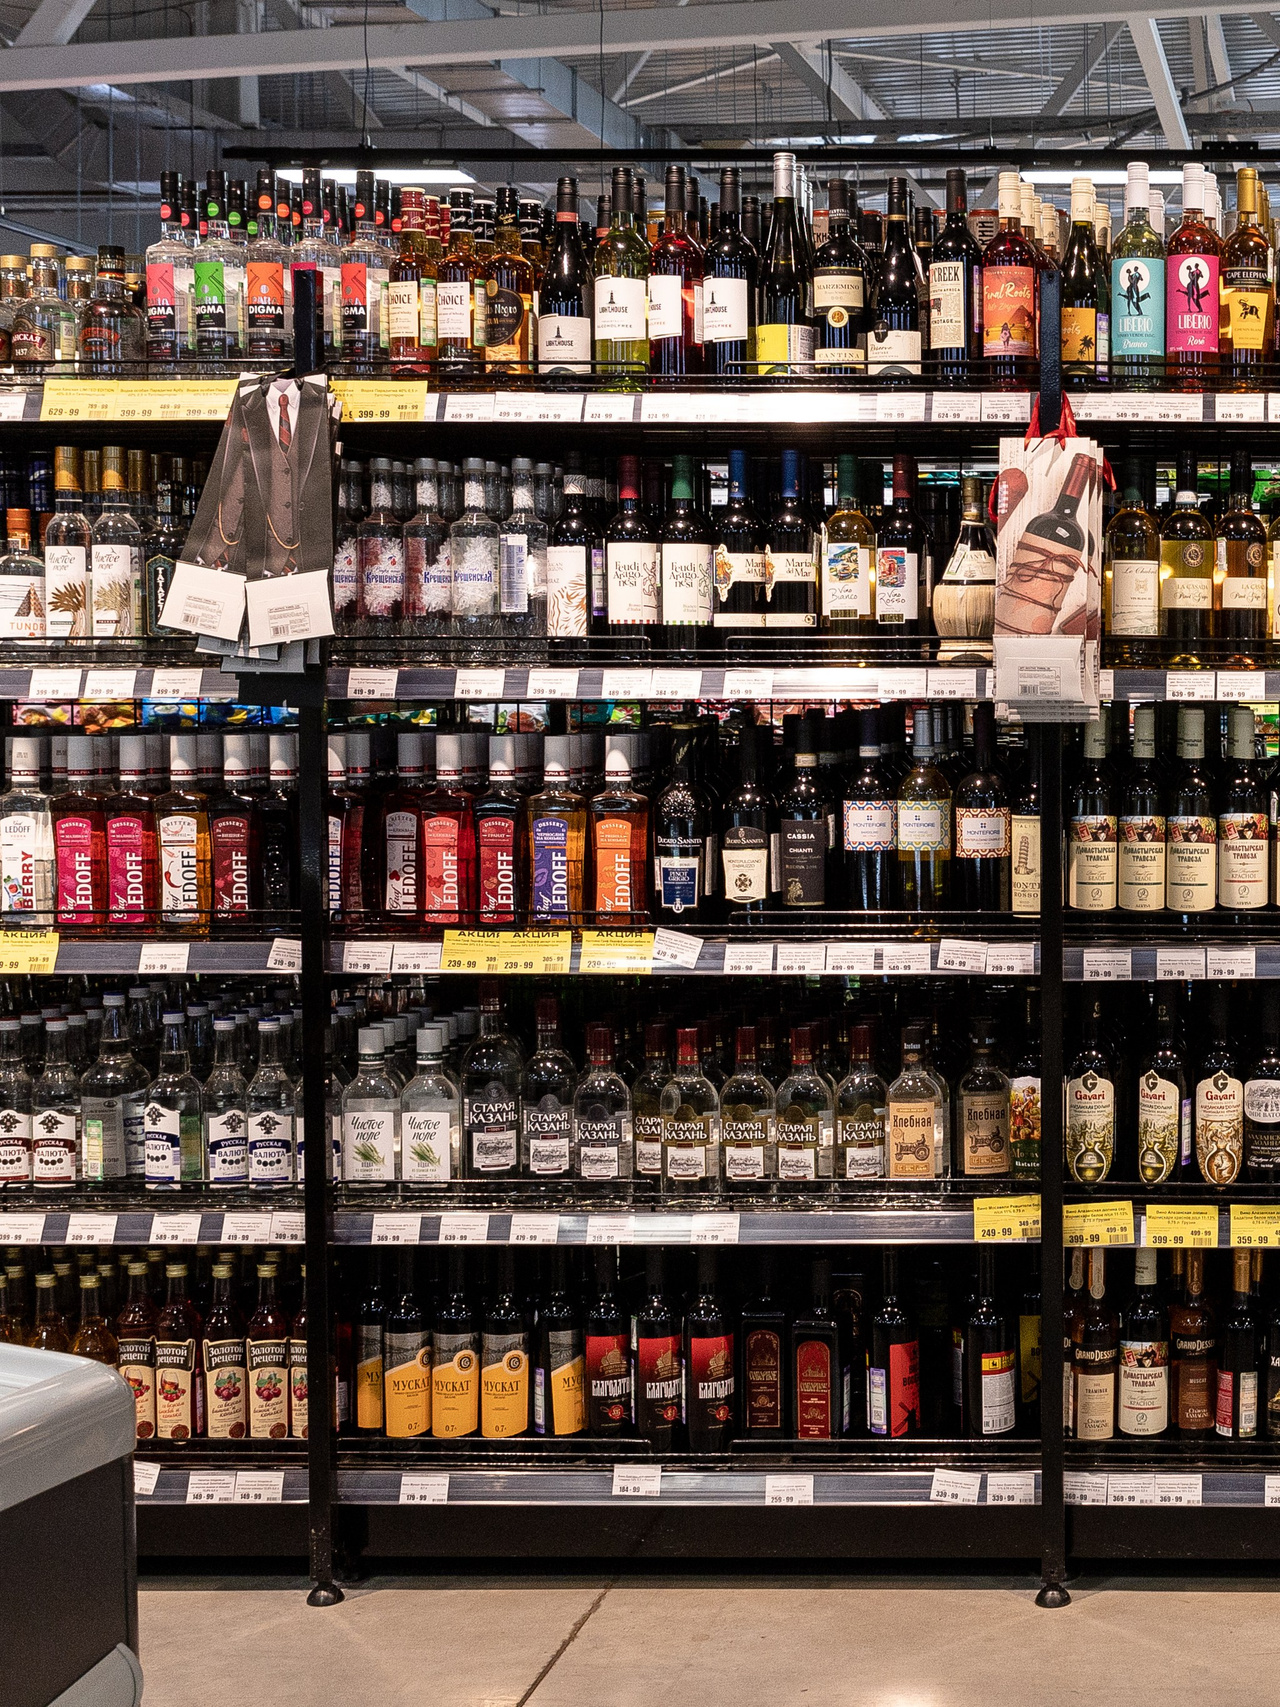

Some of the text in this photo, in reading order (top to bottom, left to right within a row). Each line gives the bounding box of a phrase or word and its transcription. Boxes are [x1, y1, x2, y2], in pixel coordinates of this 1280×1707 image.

[934, 265, 960, 282] CREEK
[249, 305, 283, 315] DIGMA
[785, 558, 812, 568] Maria
[5, 825, 31, 833] LEDOFF
[1177, 855, 1203, 863] ТРАПЕЗА
[1233, 851, 1257, 859] ТРАПЕЗА
[22, 850, 33, 909] BERRY
[75, 851, 93, 911] LEDOFF
[498, 851, 515, 911] LEDOFF
[1075, 1090, 1105, 1102] Gavari
[1205, 1090, 1235, 1101] Gavari
[472, 1102, 515, 1113] СТАРАЯ
[469, 1110, 520, 1124] КАЗАНЬ
[529, 1111, 569, 1123] СТАРАЯ
[967, 1107, 1006, 1122] Хлебная
[351, 1116, 384, 1131] Чистое
[407, 1116, 440, 1130] Чистое
[528, 1120, 571, 1132] КАЗАНЬ
[667, 1121, 704, 1131] СТАРАЯ
[893, 1115, 931, 1129] Хлебная
[664, 1129, 707, 1140] КАЗАНЬ
[36, 1149, 68, 1158] ВАЛЮТА
[209, 1344, 244, 1357] Золотой
[250, 1345, 285, 1357] Золотой
[211, 1353, 243, 1366] рецепт
[253, 1354, 283, 1365] рецепт
[392, 1377, 430, 1391] МУСКАТ
[483, 1380, 520, 1393] МУСКАТ
